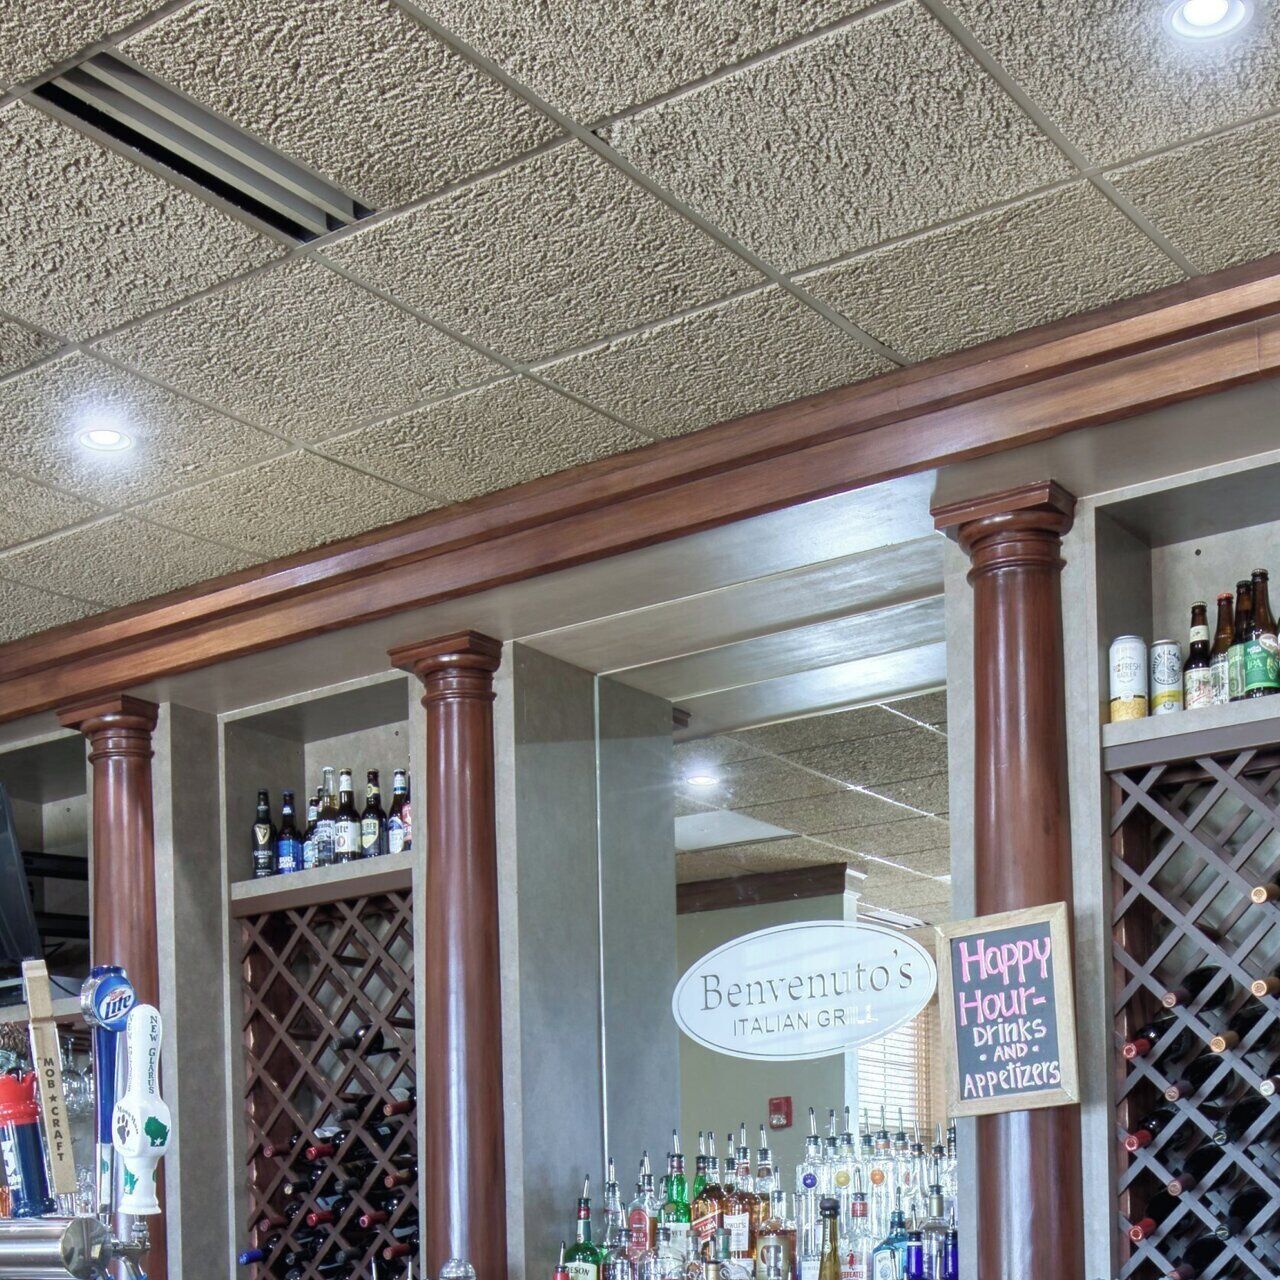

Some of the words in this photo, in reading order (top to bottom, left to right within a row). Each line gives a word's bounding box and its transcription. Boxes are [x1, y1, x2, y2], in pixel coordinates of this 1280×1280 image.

[958, 936, 1051, 984] Happy
[700, 949, 914, 1012] Benvenuto's
[104, 994, 132, 1021] Lite
[733, 1013, 810, 1037] ITALIAN
[149, 1015, 158, 1042] NEW
[148, 1047, 157, 1095] GLARUS
